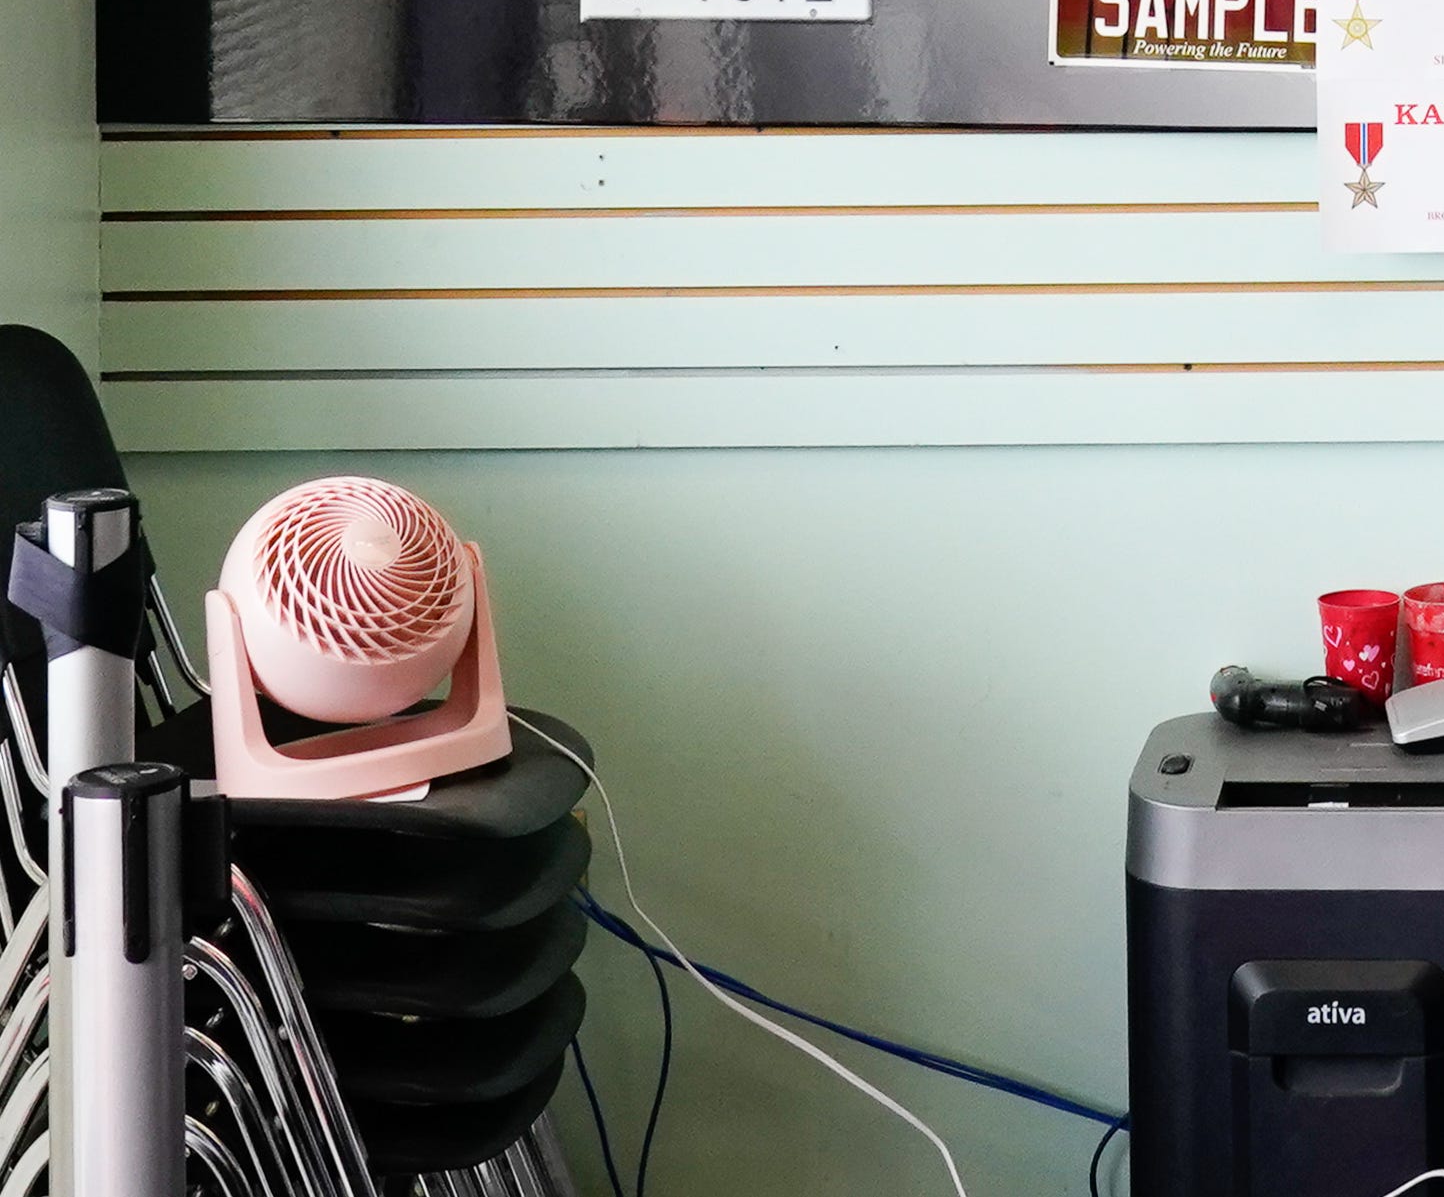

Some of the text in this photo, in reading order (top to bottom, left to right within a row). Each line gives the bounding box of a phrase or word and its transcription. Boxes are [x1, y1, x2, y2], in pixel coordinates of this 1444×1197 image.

[1133, 40, 1287, 61] Powering the Future
[1306, 1001, 1366, 1025] ativa
